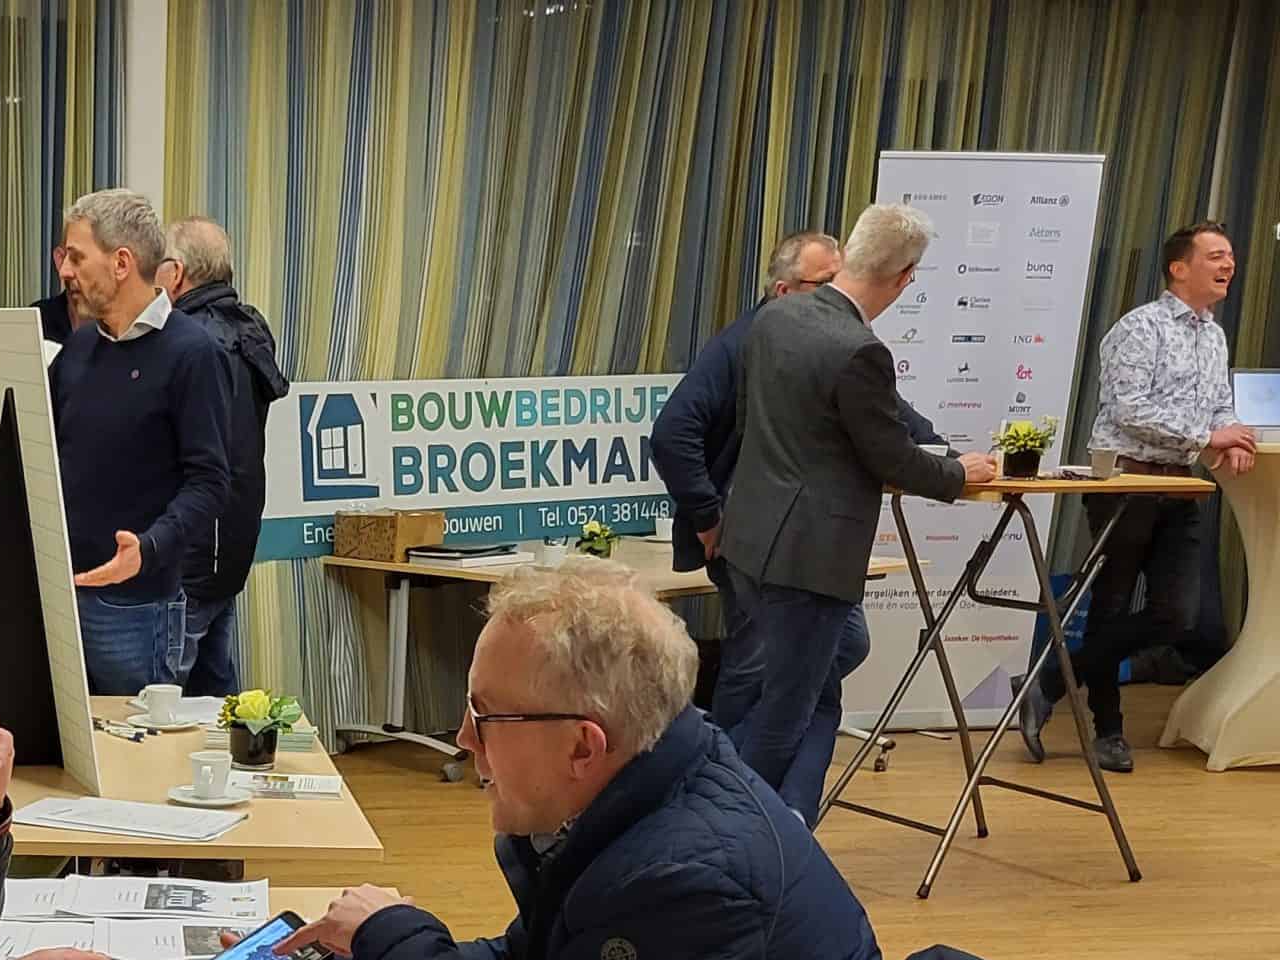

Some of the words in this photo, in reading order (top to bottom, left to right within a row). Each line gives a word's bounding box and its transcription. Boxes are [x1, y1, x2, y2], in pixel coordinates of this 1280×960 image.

[1030, 195, 1058, 205] Allianz
[1026, 261, 1054, 275] bunq
[1013, 335, 1032, 344] ING
[538, 507, 564, 527] Tel.
[567, 504, 606, 525] 0521
[612, 500, 669, 523] 381448
[865, 587, 910, 599] ergelijken
